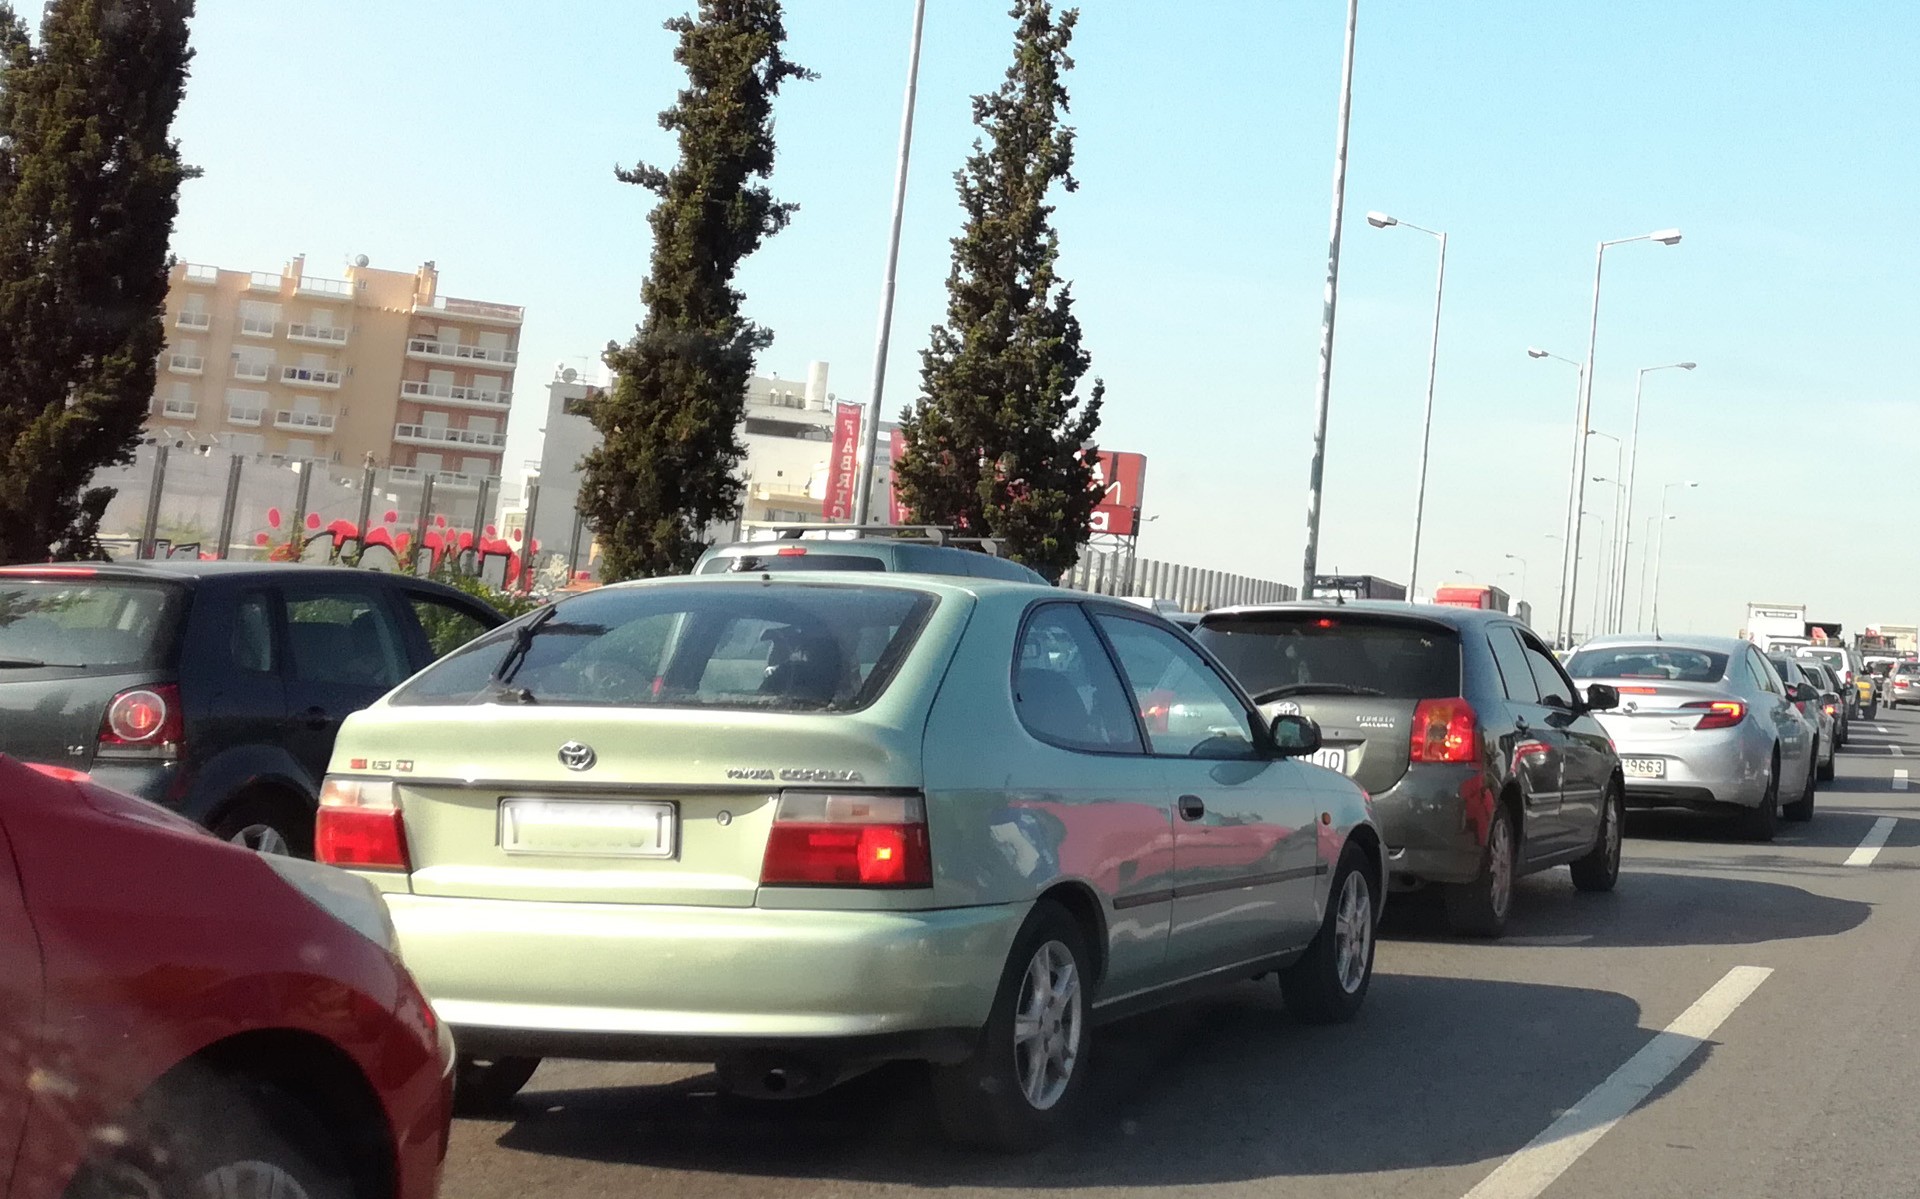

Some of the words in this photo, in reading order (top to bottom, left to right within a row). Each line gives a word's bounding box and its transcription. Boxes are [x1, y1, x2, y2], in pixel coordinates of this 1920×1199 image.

[1630, 760, 1663, 774] 9663
[725, 768, 775, 781] TOYOTA
[778, 768, 866, 783] COROLLA
